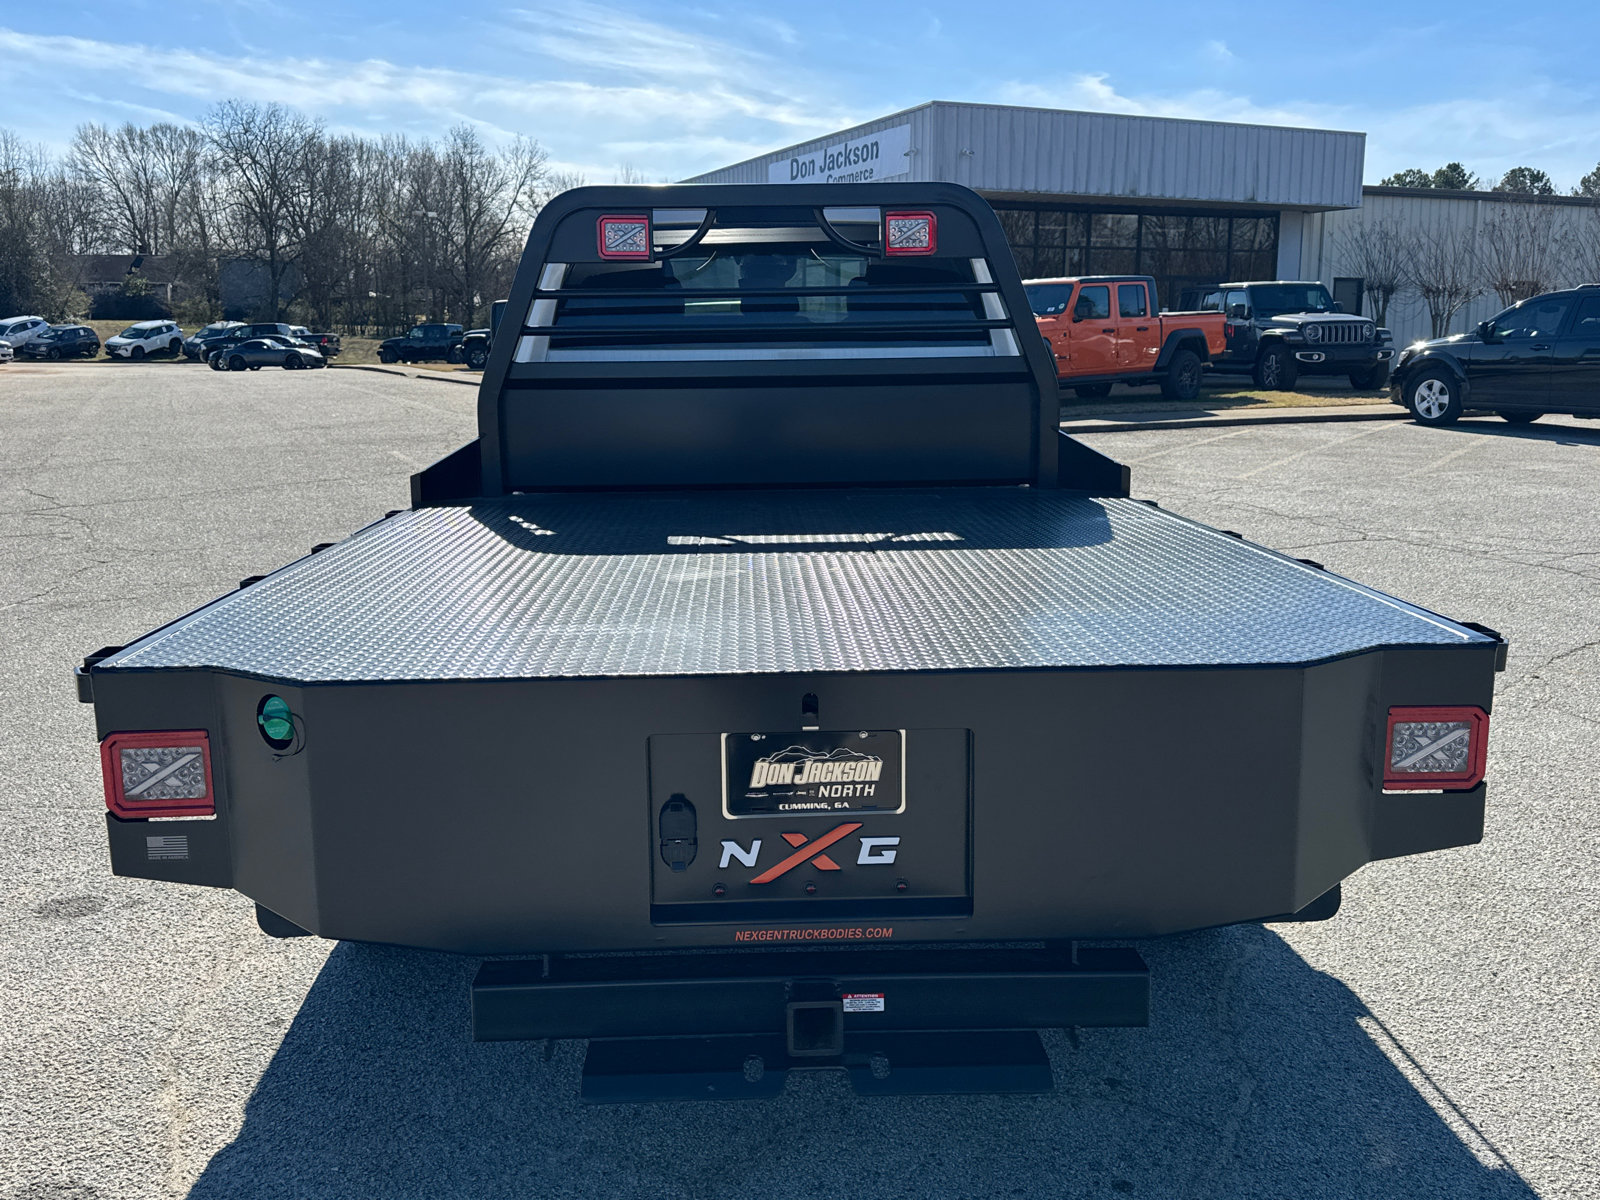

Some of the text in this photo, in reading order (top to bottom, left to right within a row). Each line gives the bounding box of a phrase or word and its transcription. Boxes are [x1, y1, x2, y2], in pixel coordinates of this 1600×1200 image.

[790, 140, 879, 181] Don Jackson
[826, 167, 874, 184] Commerce
[749, 760, 883, 788] DON JACKSON
[818, 784, 876, 798] NORTH
[779, 803, 831, 811] CUMMING,
[735, 927, 894, 942] NEXGENTRUCKBODIES.COM
